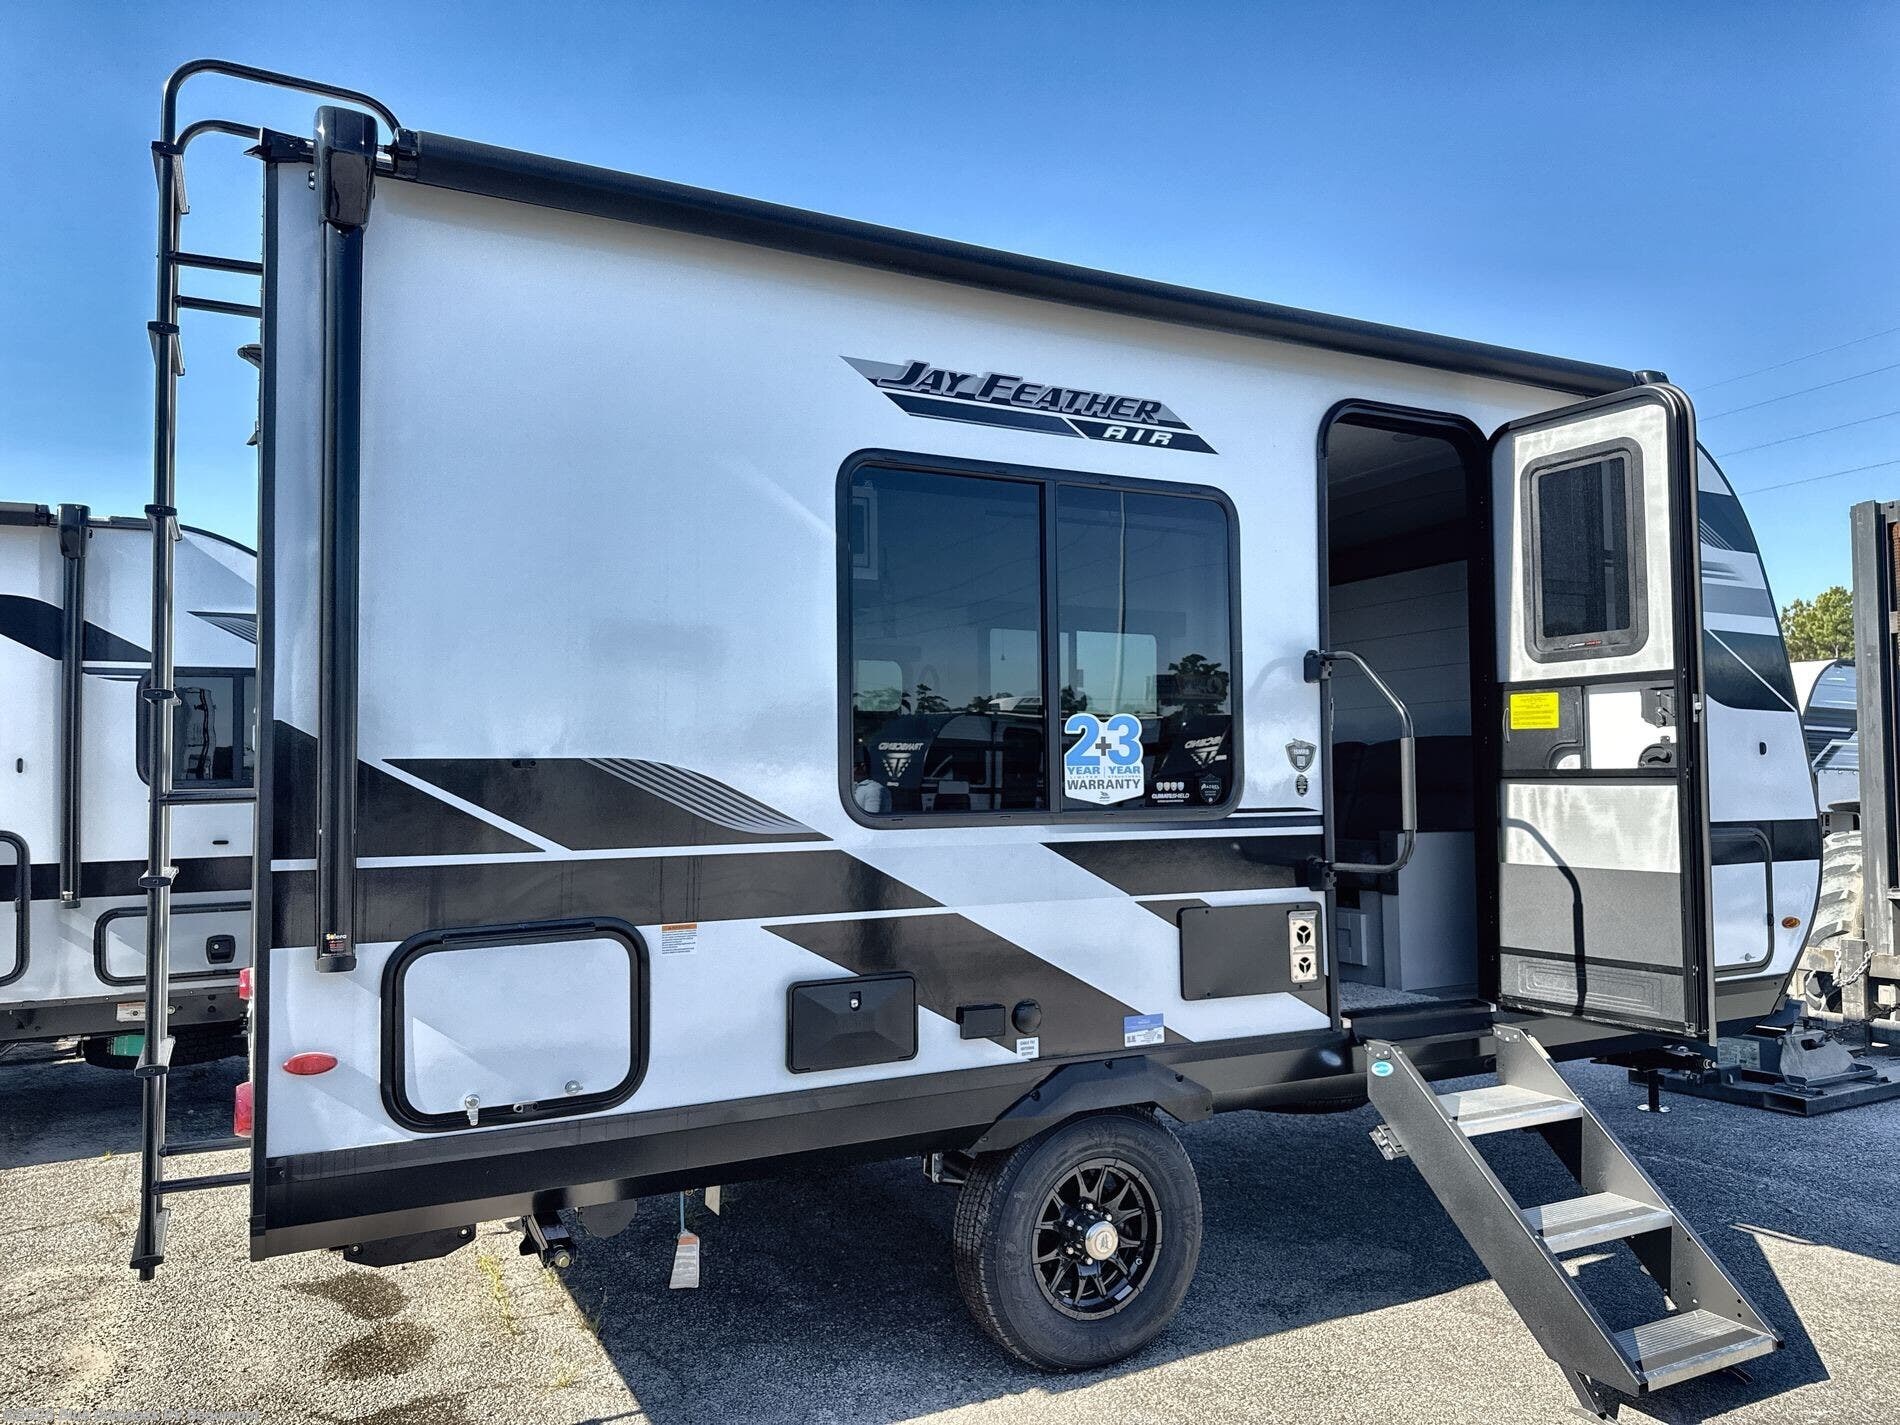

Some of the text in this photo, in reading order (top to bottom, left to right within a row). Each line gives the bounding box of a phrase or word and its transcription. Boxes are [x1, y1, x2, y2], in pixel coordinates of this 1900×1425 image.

[878, 361, 1162, 424] JAY FEATHER
[1103, 426, 1173, 446] AIR
[1067, 765, 1141, 775] YEAR YEAR
[1067, 779, 1141, 790] WARRANTY
